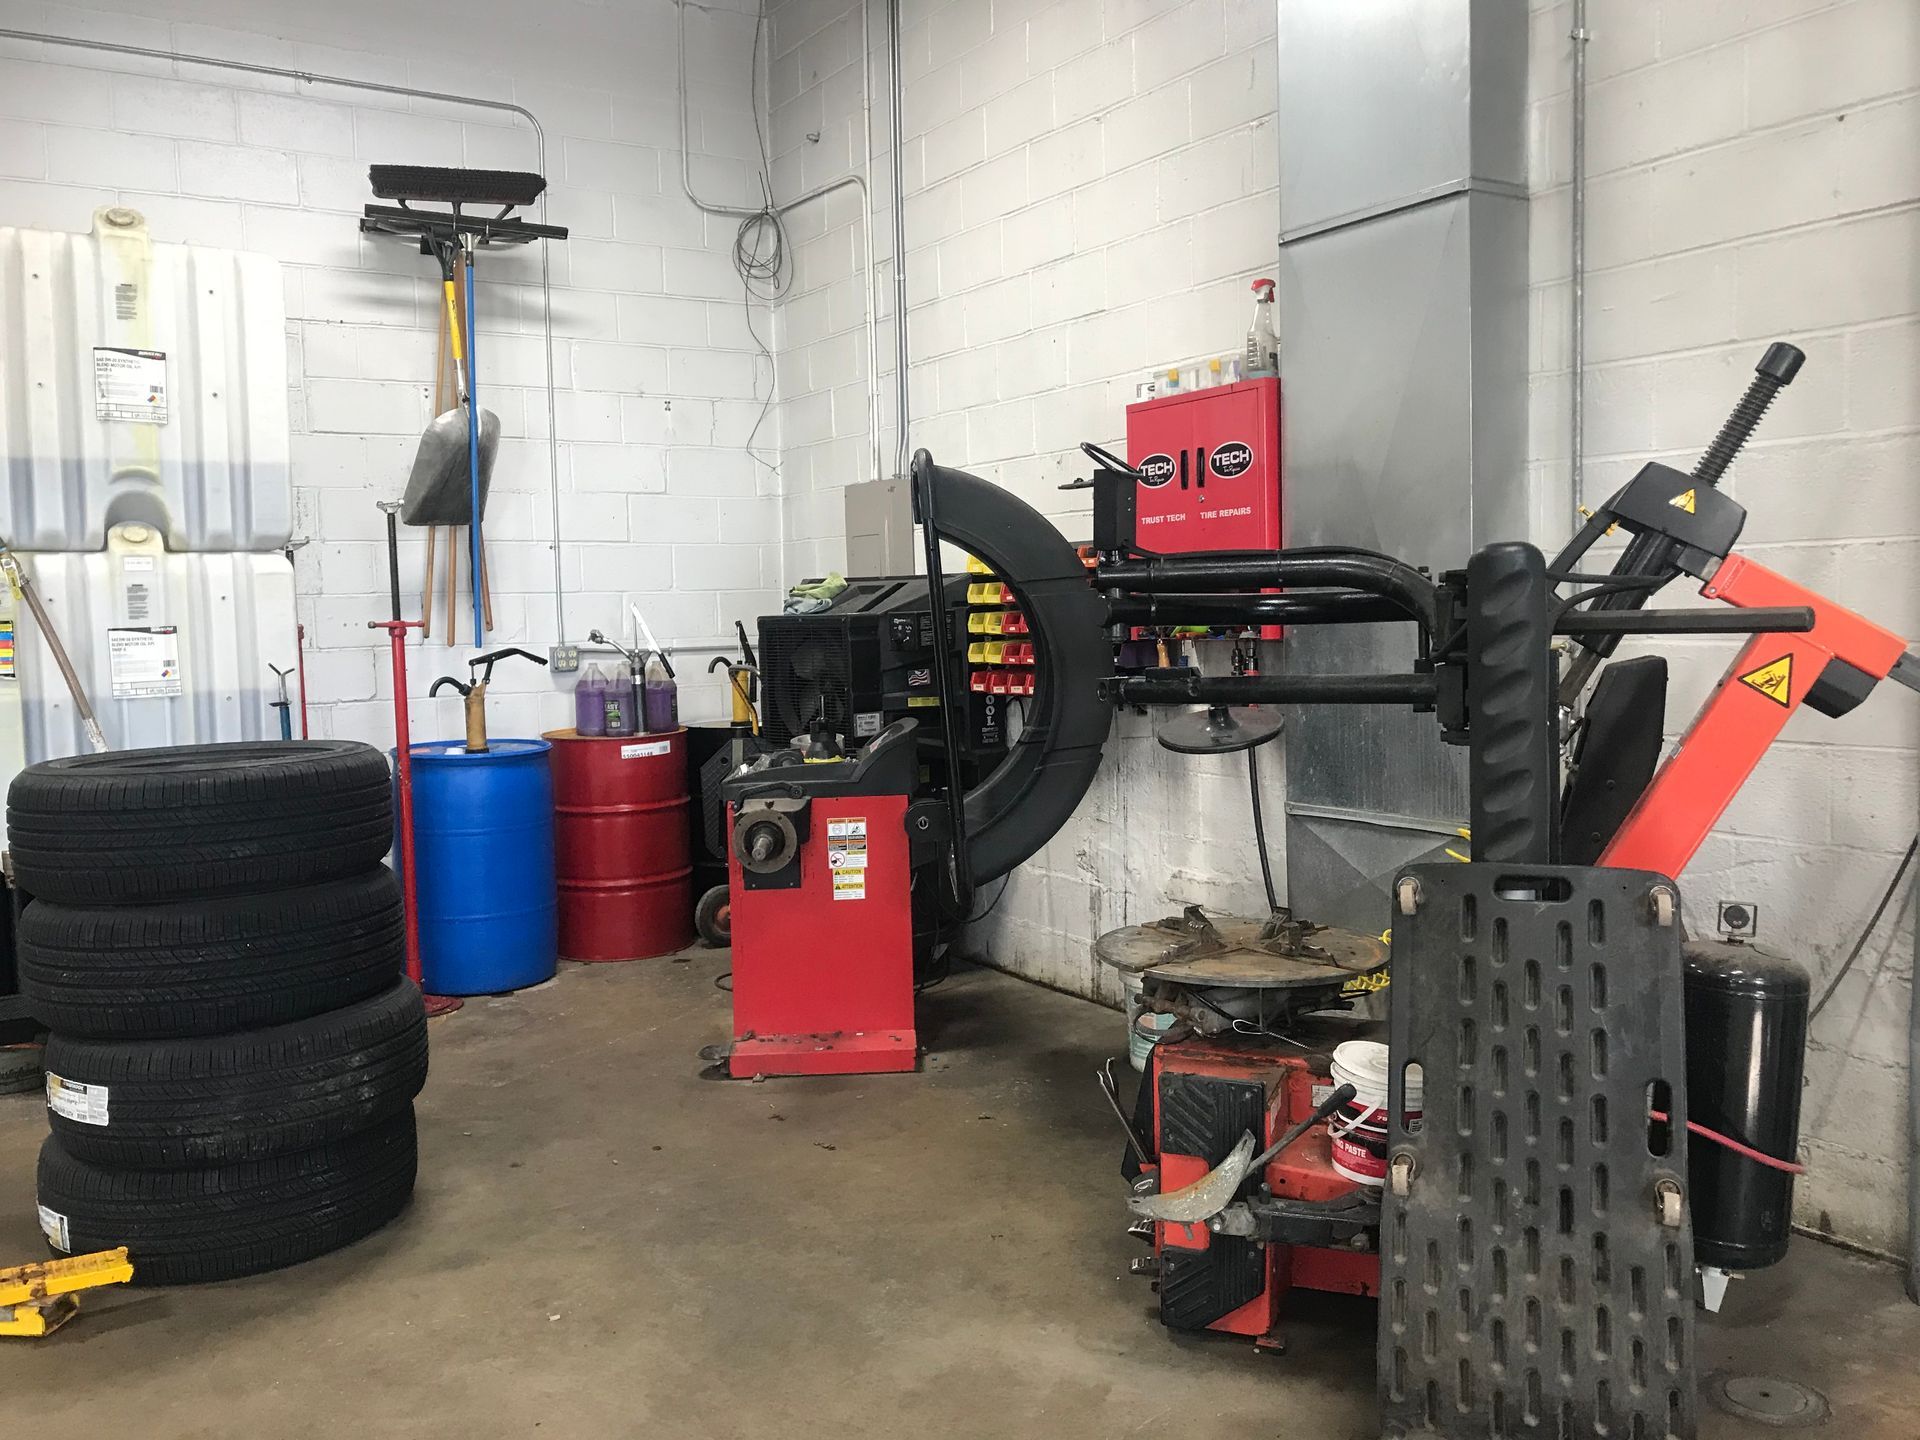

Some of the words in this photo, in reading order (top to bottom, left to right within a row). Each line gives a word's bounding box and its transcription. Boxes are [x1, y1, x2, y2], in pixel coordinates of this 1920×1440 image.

[1213, 449, 1250, 467] TECH
[1140, 461, 1173, 477] TECH
[1141, 515, 1165, 525] TRUST
[1166, 513, 1187, 522] TECH
[1199, 510, 1218, 520] TIRE
[1218, 506, 1252, 518] REPAIRS
[1344, 1142, 1367, 1158] PASTE
